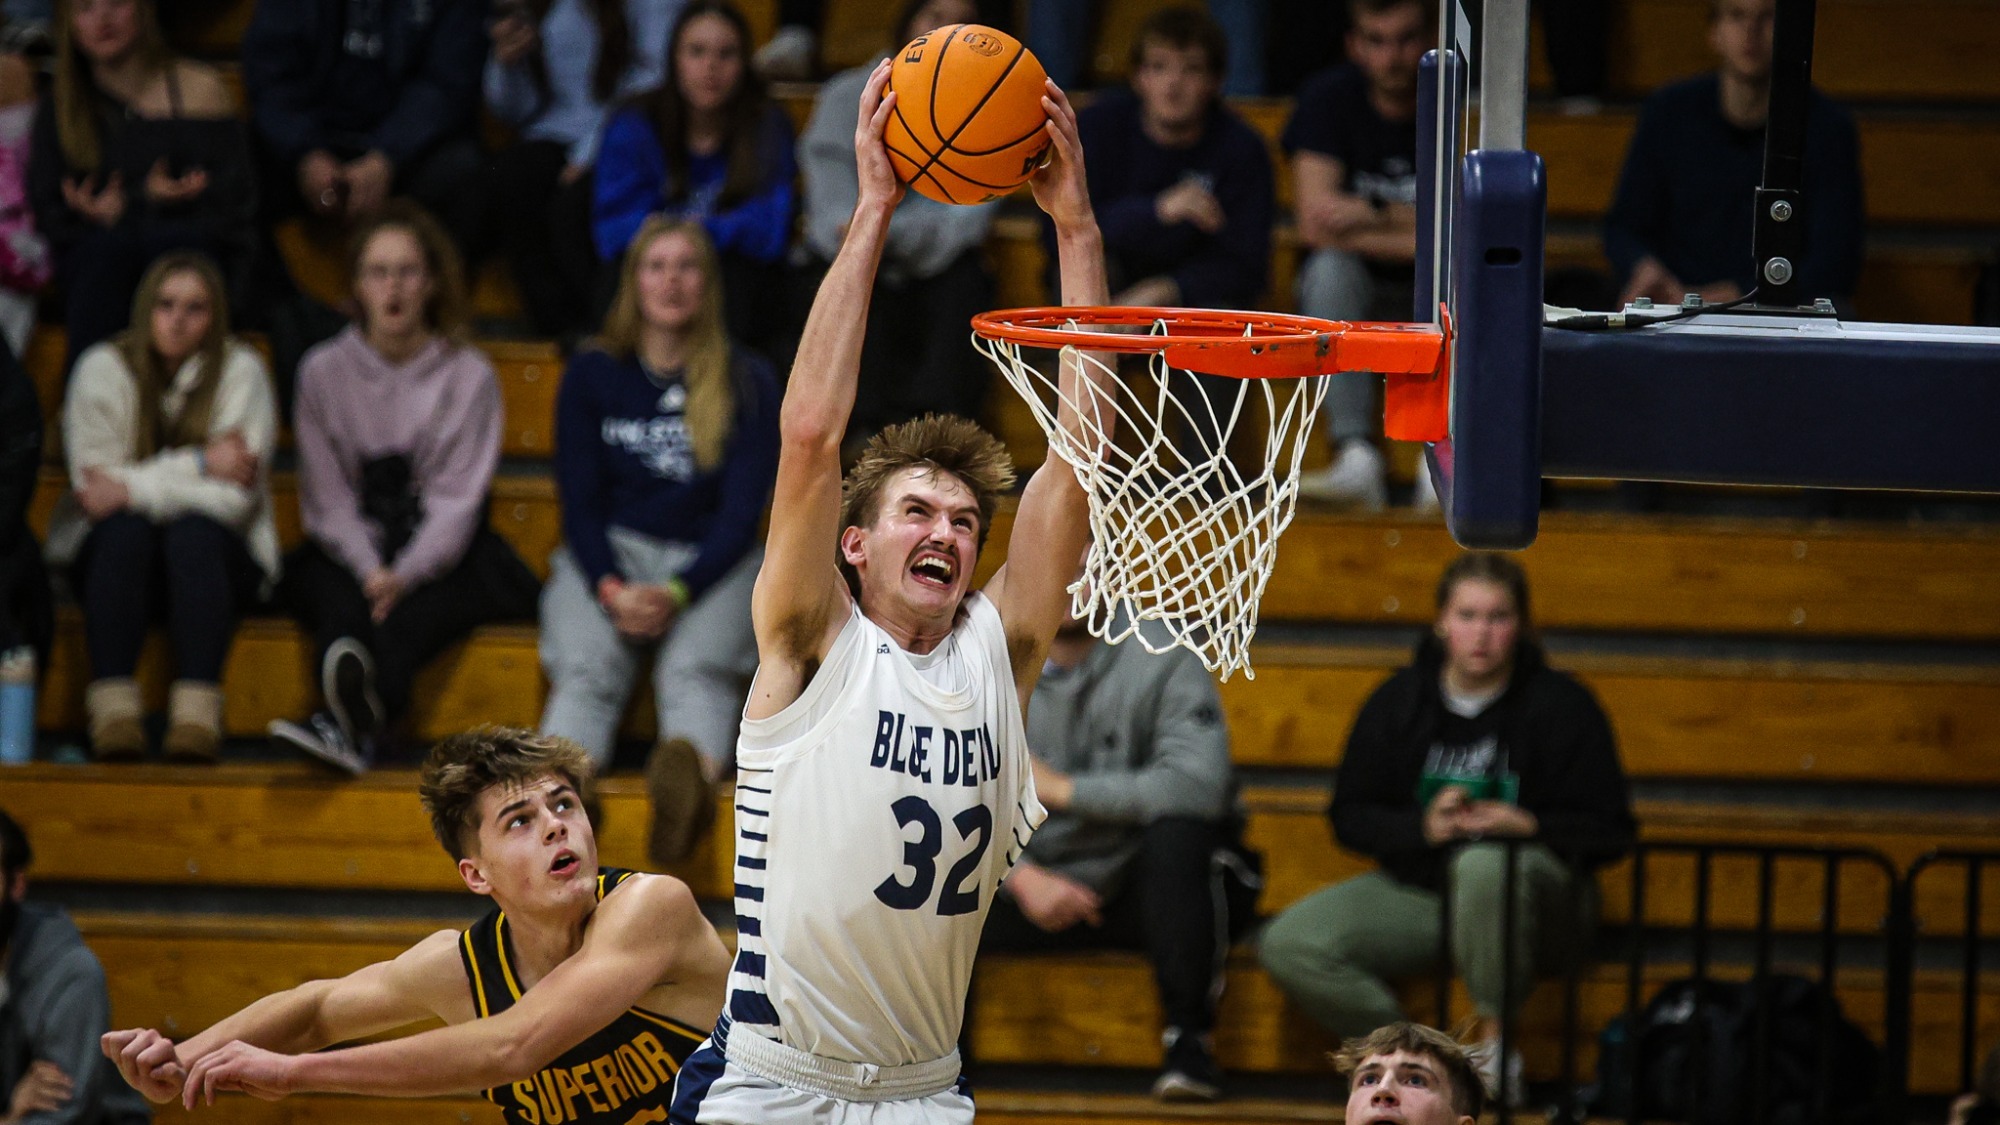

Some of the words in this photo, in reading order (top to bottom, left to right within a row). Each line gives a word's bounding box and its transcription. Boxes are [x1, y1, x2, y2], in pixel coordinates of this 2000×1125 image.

[905, 30, 934, 64] EV
[870, 709, 933, 784] BLUE
[873, 795, 992, 916] 32
